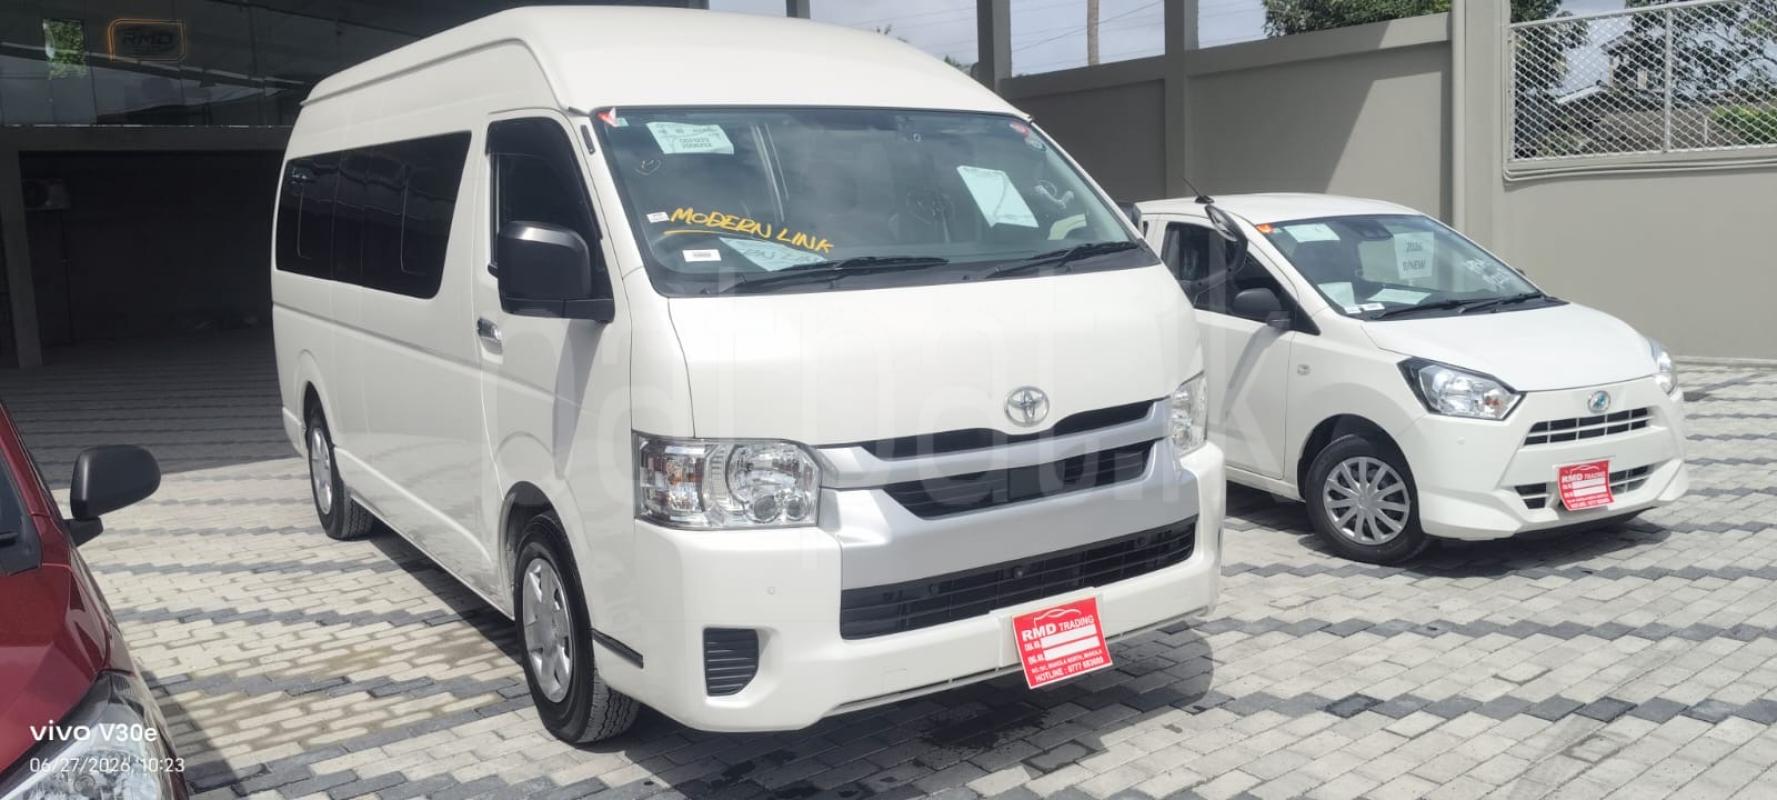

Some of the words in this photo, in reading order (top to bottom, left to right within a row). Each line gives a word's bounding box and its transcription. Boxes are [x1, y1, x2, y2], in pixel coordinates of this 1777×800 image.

[121, 31, 174, 46] RMD
[670, 207, 772, 239] MODERN
[776, 228, 834, 253] LINK
[1021, 623, 1057, 641] RMD
[1058, 614, 1094, 631] TRADING
[1034, 667, 1064, 682] HOTLINE
